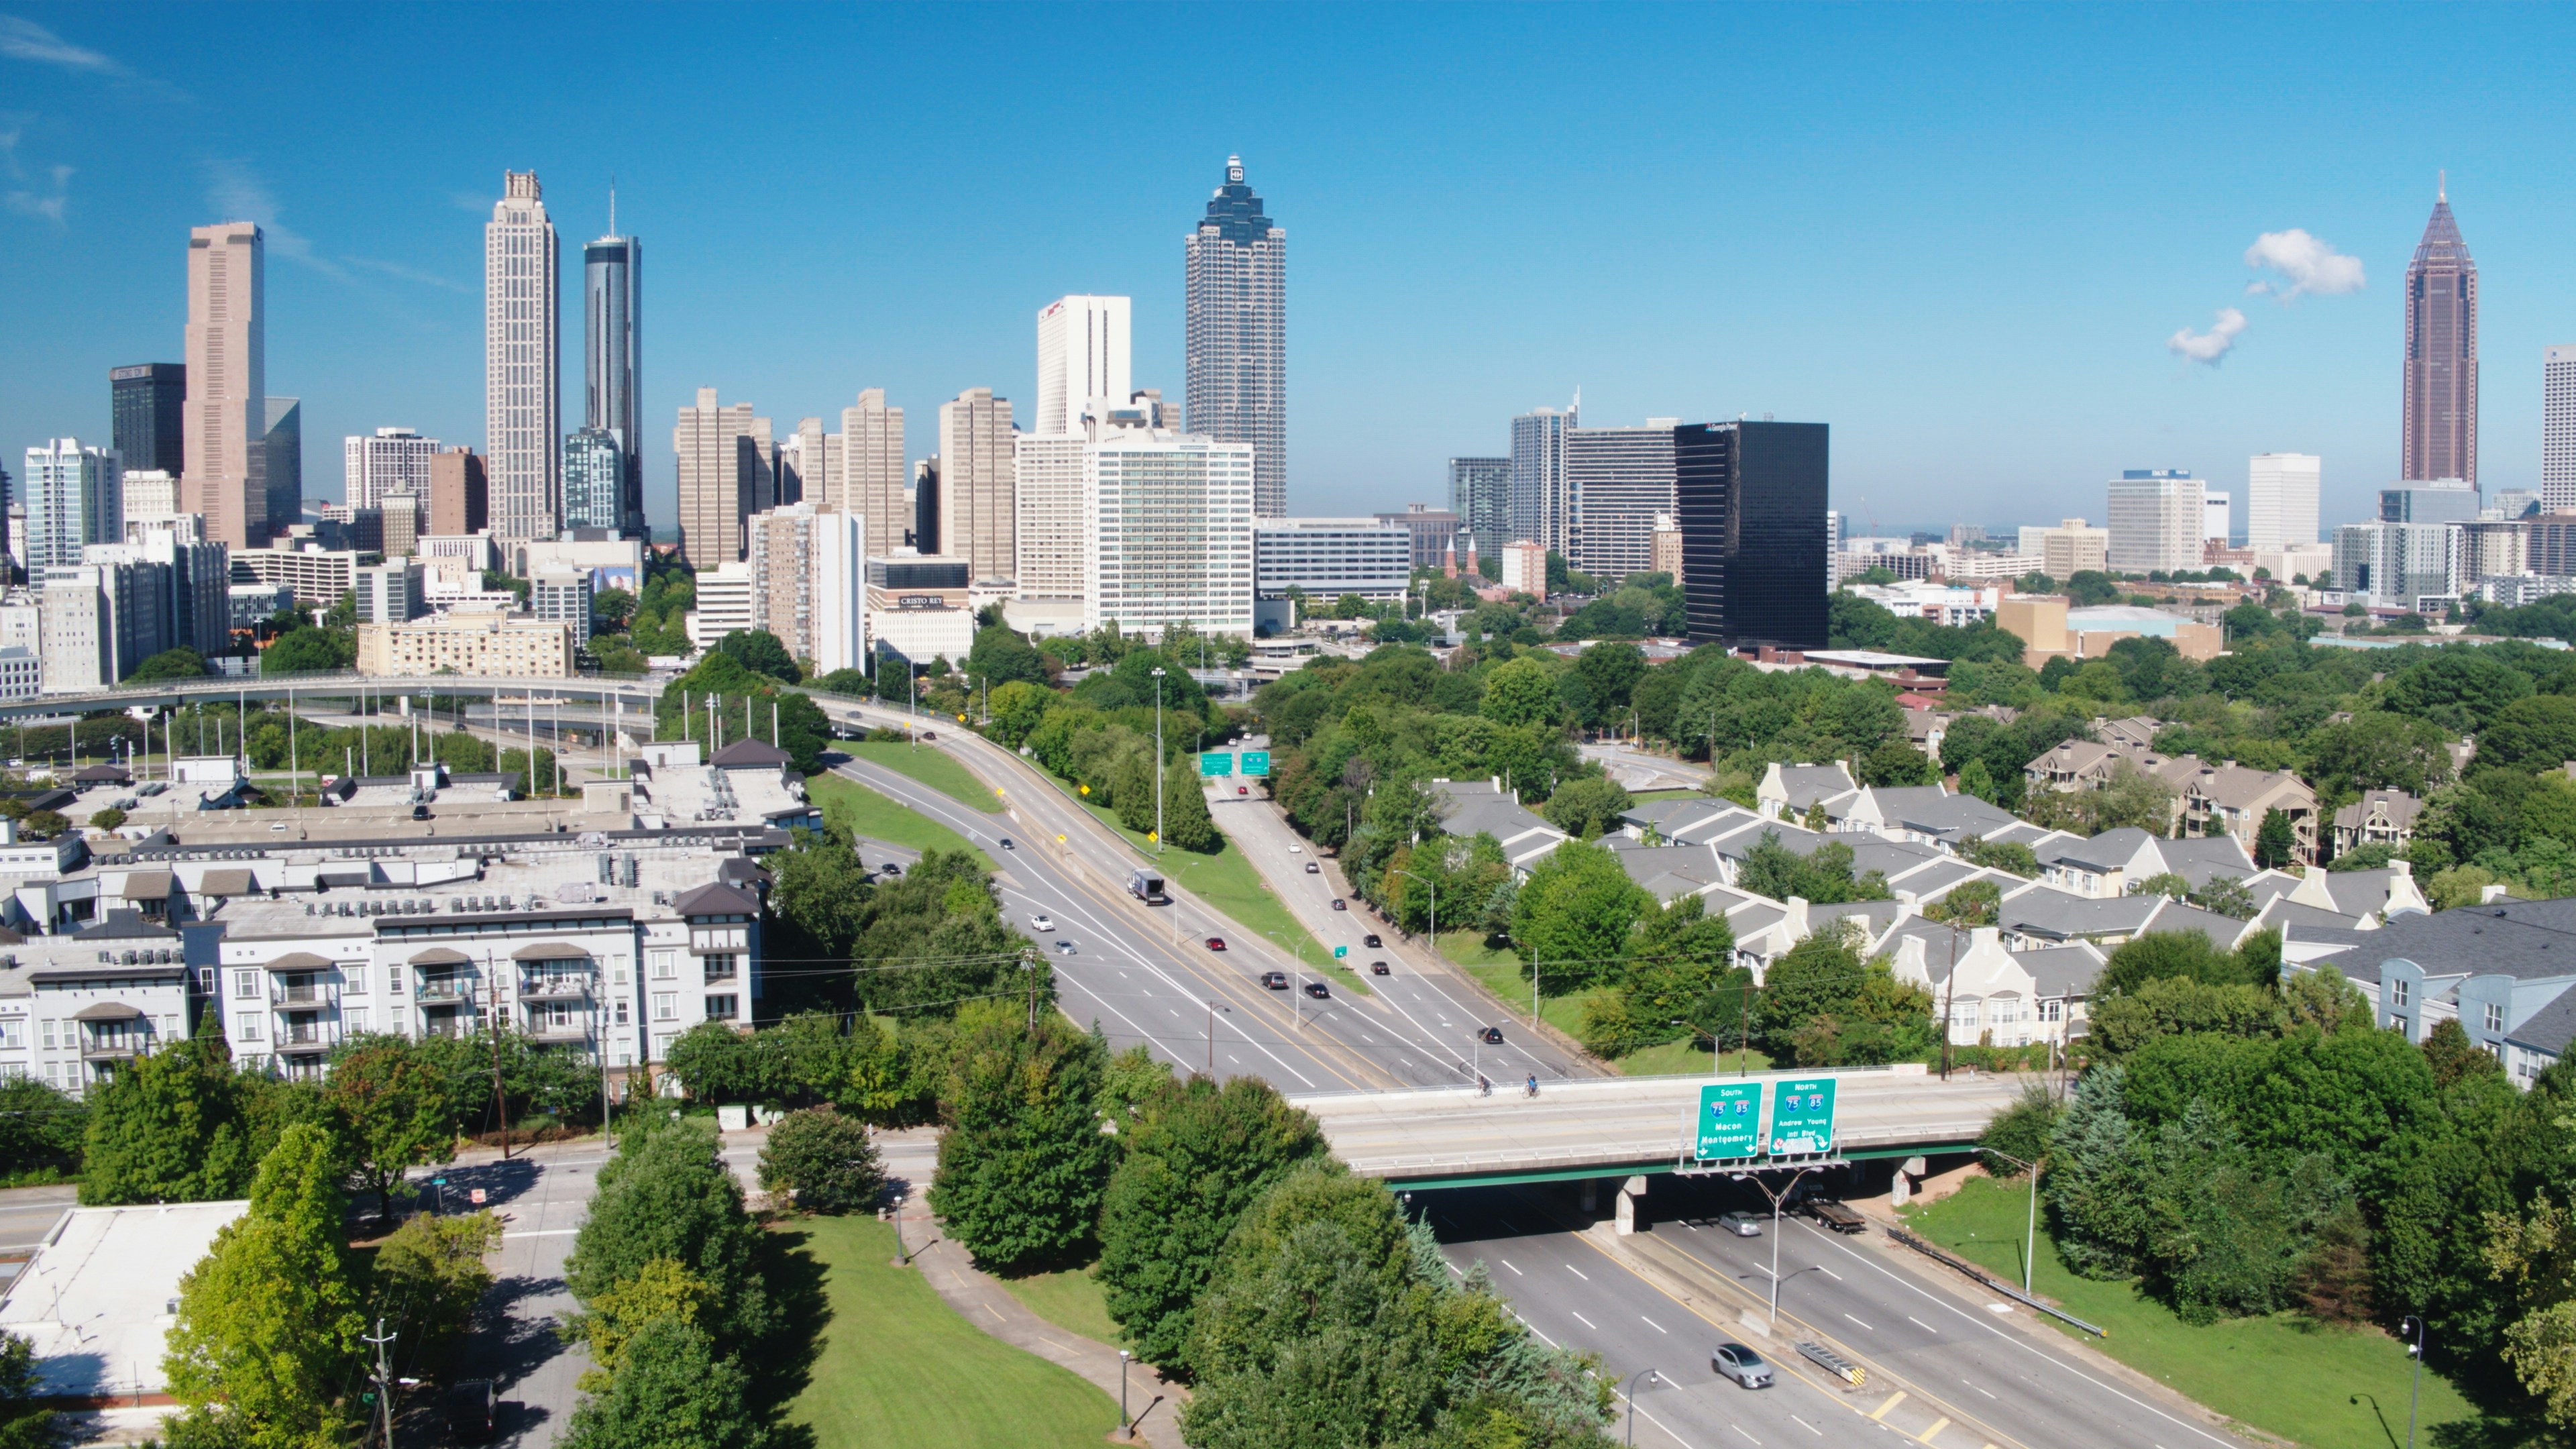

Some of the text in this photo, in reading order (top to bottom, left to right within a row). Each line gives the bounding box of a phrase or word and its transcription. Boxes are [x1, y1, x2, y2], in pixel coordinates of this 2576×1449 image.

[1721, 1089, 1743, 1097] SOUTH
[1787, 1099, 1821, 1108] 75 85
[1712, 1104, 1748, 1114] 75 85
[1715, 1122, 1741, 1131] Macon
[1807, 1118, 1827, 1126] Young
[1801, 1130, 1816, 1138] Blvd
[1702, 1134, 1753, 1145] Montgomery
